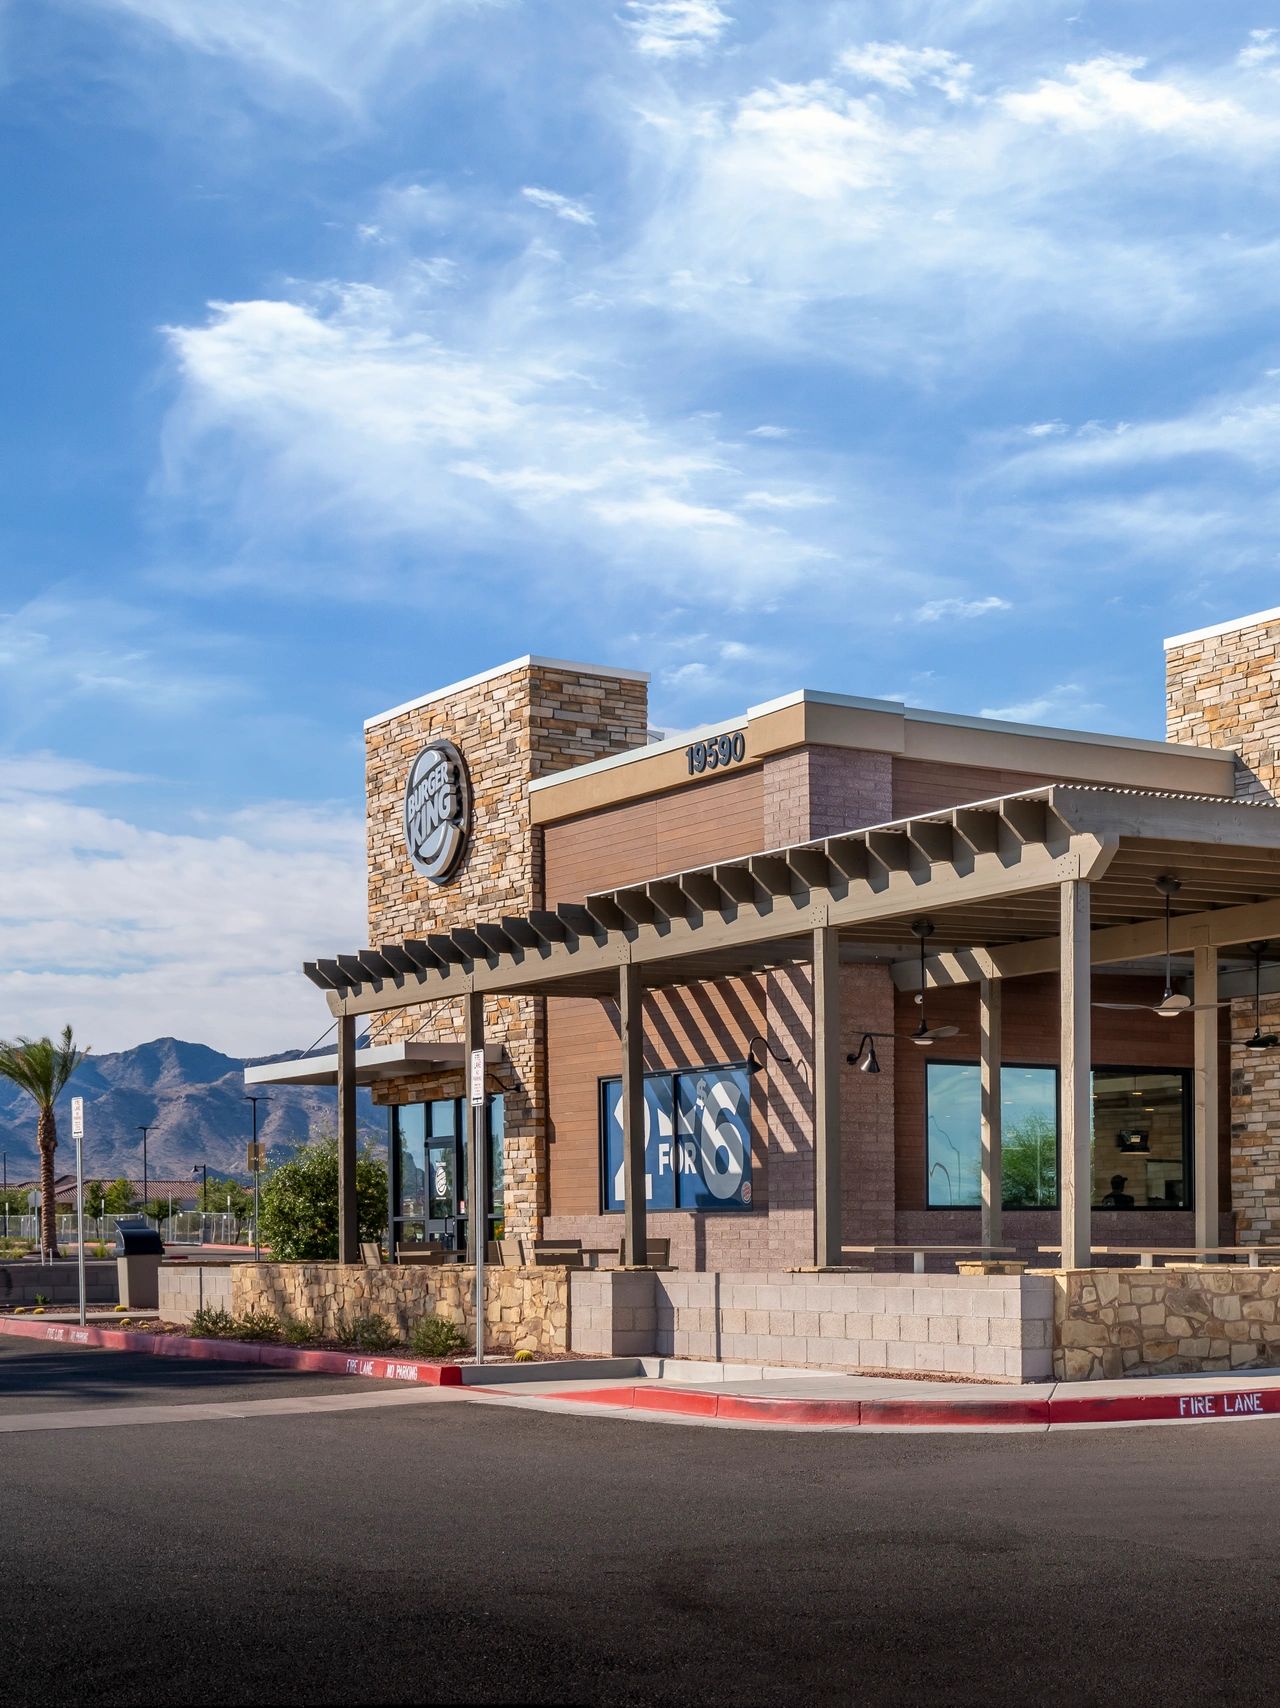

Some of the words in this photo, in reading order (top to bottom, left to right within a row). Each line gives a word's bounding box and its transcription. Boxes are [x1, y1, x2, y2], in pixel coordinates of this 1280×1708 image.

[685, 732, 745, 775] 19590
[407, 761, 449, 822] BURGER
[410, 783, 451, 857] KING
[658, 1141, 697, 1176] FOR
[1179, 1396, 1216, 1416] FIRE
[1223, 1393, 1264, 1413] LANE
